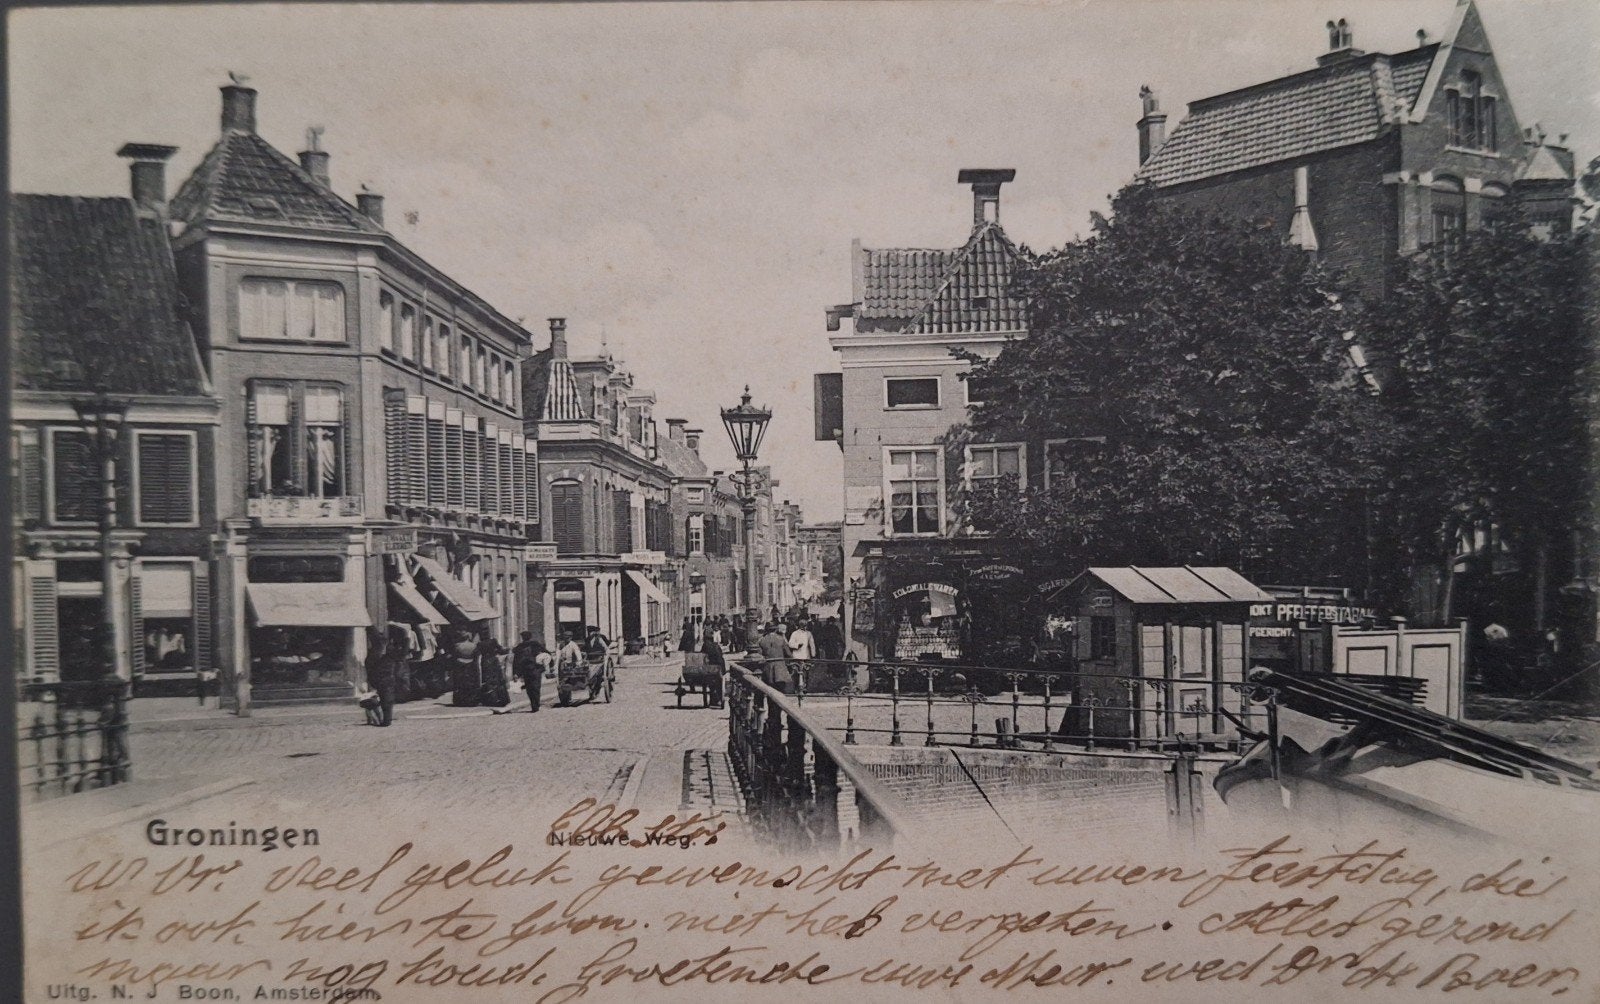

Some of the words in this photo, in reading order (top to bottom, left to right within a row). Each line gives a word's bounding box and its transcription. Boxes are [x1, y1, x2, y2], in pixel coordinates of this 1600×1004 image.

[374, 845, 573, 915] geluk
[562, 848, 901, 917] gewenscht
[905, 845, 1044, 889] met
[76, 900, 143, 942] ik
[412, 898, 498, 948] te
[663, 891, 788, 936] niet
[785, 895, 899, 939] heb
[284, 958, 389, 1004] nog
